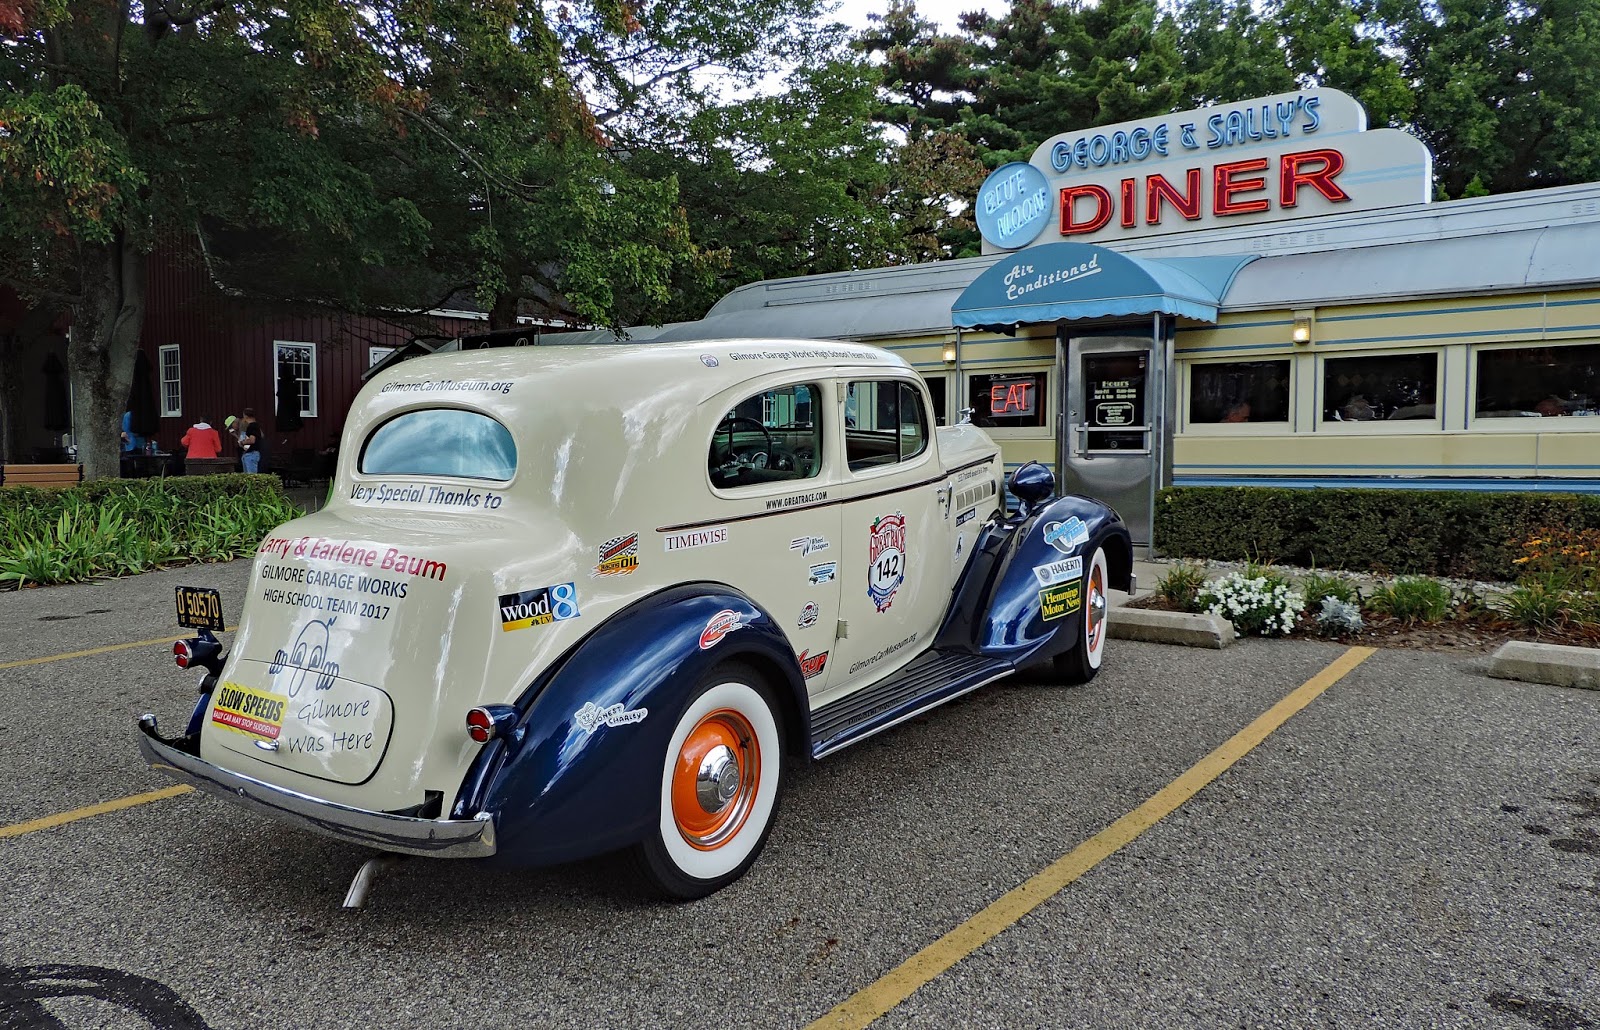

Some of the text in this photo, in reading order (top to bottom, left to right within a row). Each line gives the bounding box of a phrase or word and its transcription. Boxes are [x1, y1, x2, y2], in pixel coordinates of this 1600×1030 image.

[1051, 95, 1320, 173] GEORGE & SALLY'S
[984, 168, 1026, 215] BLUE
[1059, 148, 1351, 236] DINER
[997, 187, 1047, 240] MOON
[1004, 264, 1034, 285] Air
[1006, 254, 1098, 300] Conditioned
[729, 351, 763, 361] Gilmore
[763, 351, 791, 360] Garage
[791, 350, 813, 359] Works
[814, 350, 829, 359] High
[829, 350, 849, 358] School
[849, 351, 864, 359] Team
[381, 380, 514, 394] GilmoreCarMuseum.org
[991, 383, 1032, 413] EAT
[350, 483, 503, 509] Very Special Thanks to
[765, 491, 828, 510] WWW.GREATRACE.COM
[666, 528, 728, 550] TIMEWISE
[1046, 517, 1080, 542] COKER
[260, 535, 447, 581] Larry & Earlene Baum
[604, 536, 635, 559] CHAMPION
[621, 556, 640, 568] OIL
[877, 554, 899, 582] 142
[1050, 558, 1081, 575] HAGERTY
[262, 565, 408, 598] GILMORE GARAGE WORKS
[186, 592, 219, 619] 50570
[263, 588, 390, 620] HIGH SCHOOL TEAM 2017
[500, 584, 578, 622] wood 8
[1043, 597, 1080, 616] Motor News
[1045, 587, 1078, 605] Hemmings
[540, 614, 552, 625] tv
[849, 632, 918, 674] GilmoreCarMuseum.org
[218, 687, 284, 722] SLOW SPEEDS
[297, 699, 370, 725] Gilmore
[223, 713, 233, 722] CAR
[232, 716, 242, 725] MAY
[241, 719, 253, 729] STOP
[253, 722, 278, 735] SUDDENLY
[332, 731, 373, 750] Here
